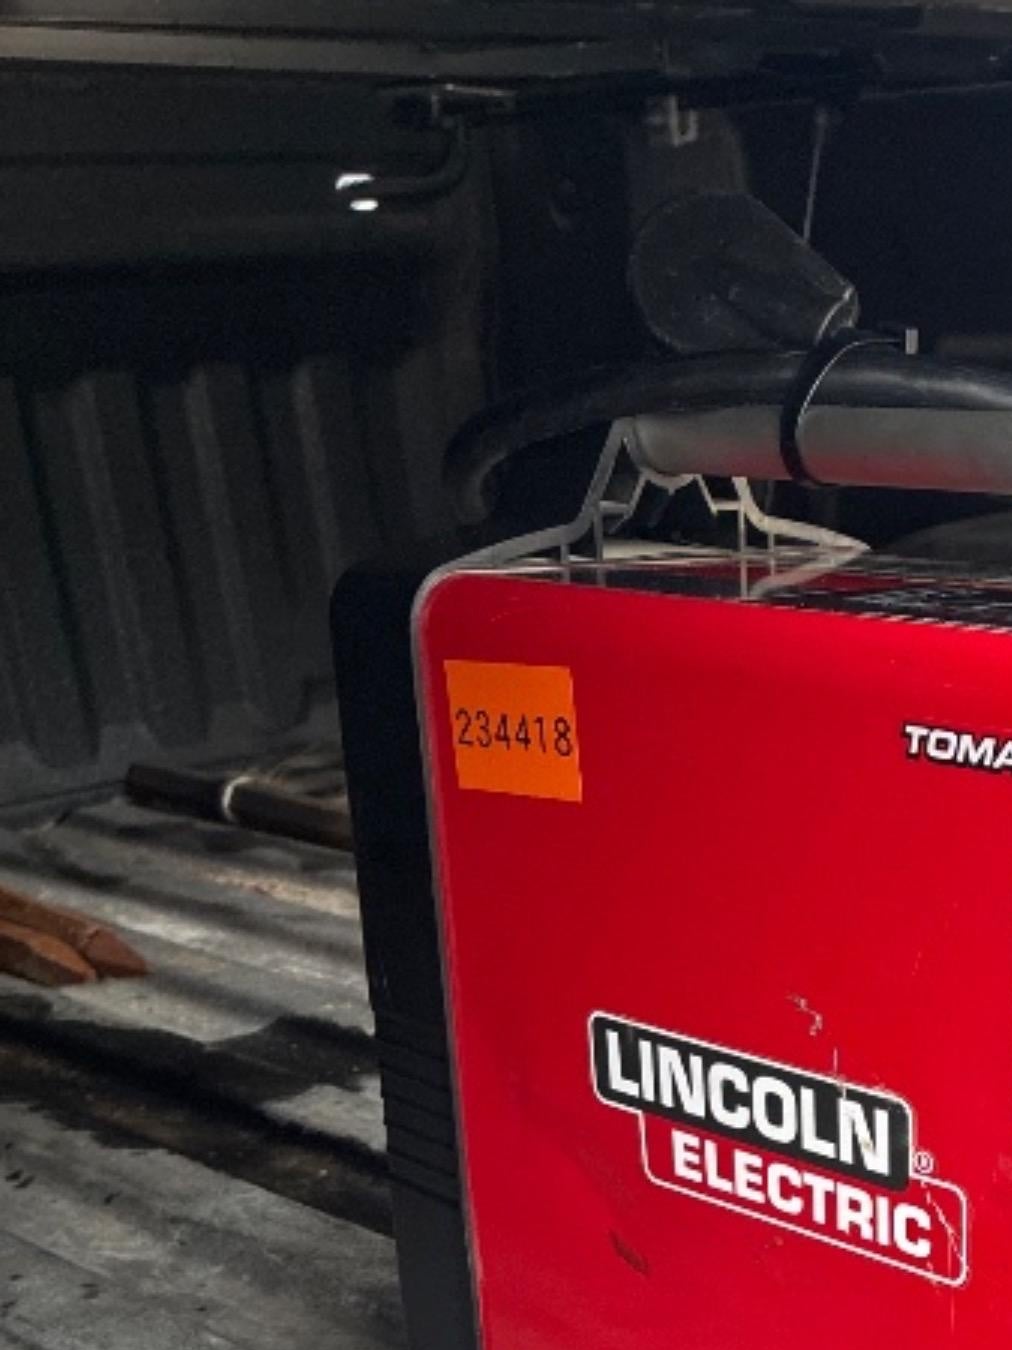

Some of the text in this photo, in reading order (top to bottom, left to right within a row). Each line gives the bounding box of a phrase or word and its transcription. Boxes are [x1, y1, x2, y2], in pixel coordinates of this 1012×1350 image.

[455, 707, 574, 757] 234418
[604, 1028, 890, 1177] LINCOLN
[671, 1128, 932, 1258] ELECTRIC
